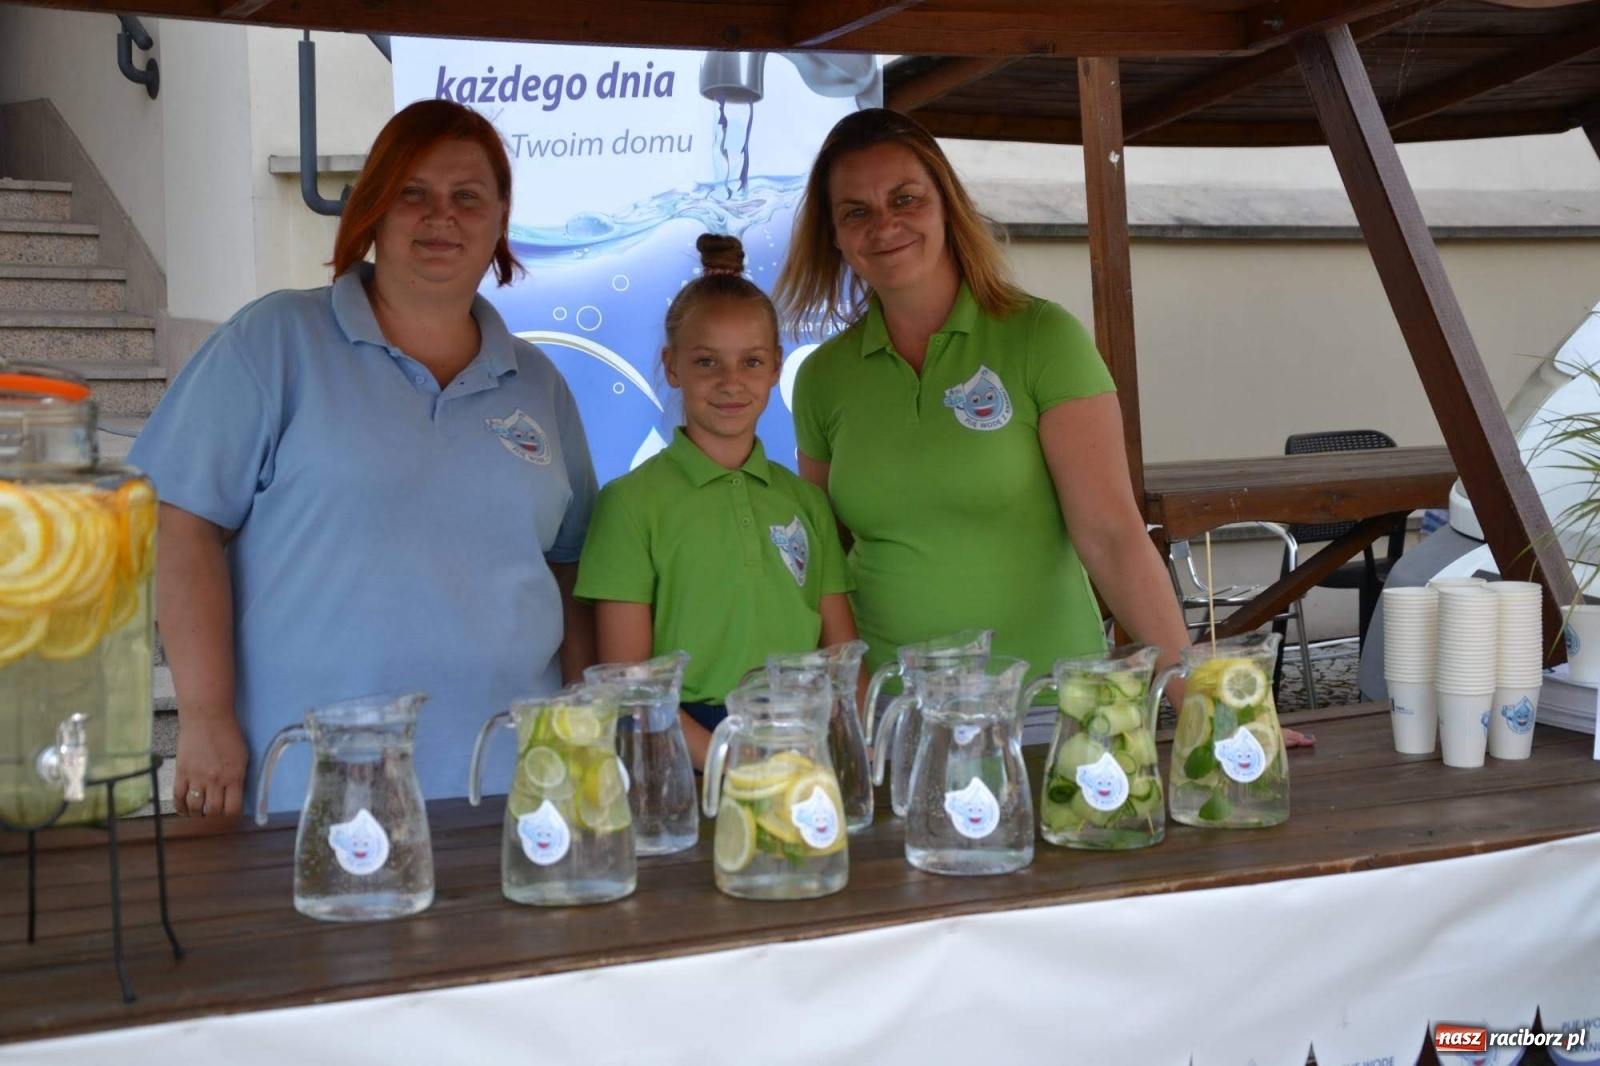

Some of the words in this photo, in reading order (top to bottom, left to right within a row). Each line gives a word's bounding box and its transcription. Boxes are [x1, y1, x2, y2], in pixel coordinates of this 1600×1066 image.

[435, 64, 587, 111] każdego
[596, 61, 675, 99] dnia
[511, 132, 603, 158] Twoim
[612, 129, 693, 155] domu
